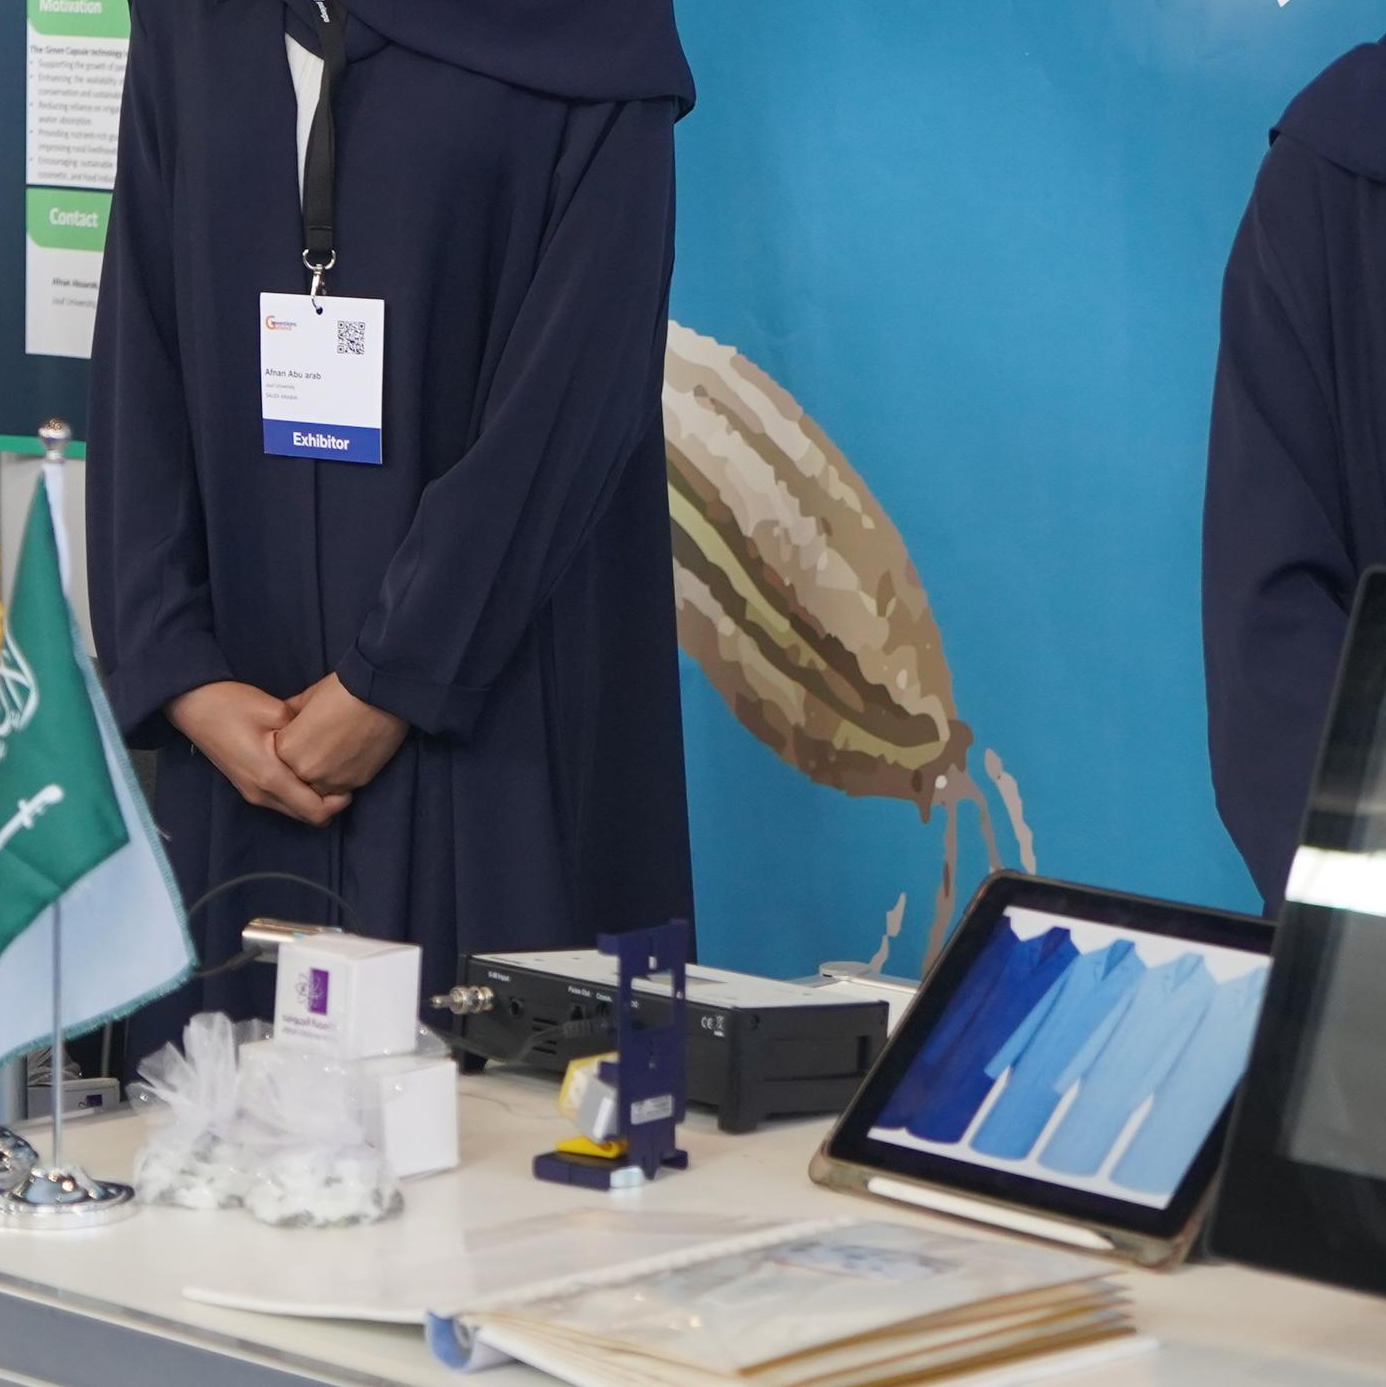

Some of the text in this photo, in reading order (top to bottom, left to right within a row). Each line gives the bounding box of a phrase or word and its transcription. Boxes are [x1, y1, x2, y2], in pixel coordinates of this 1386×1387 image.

[48, 207, 99, 228] Contact
[265, 368, 322, 380] Afnan Abu arab
[292, 431, 350, 451] Exhibitor
